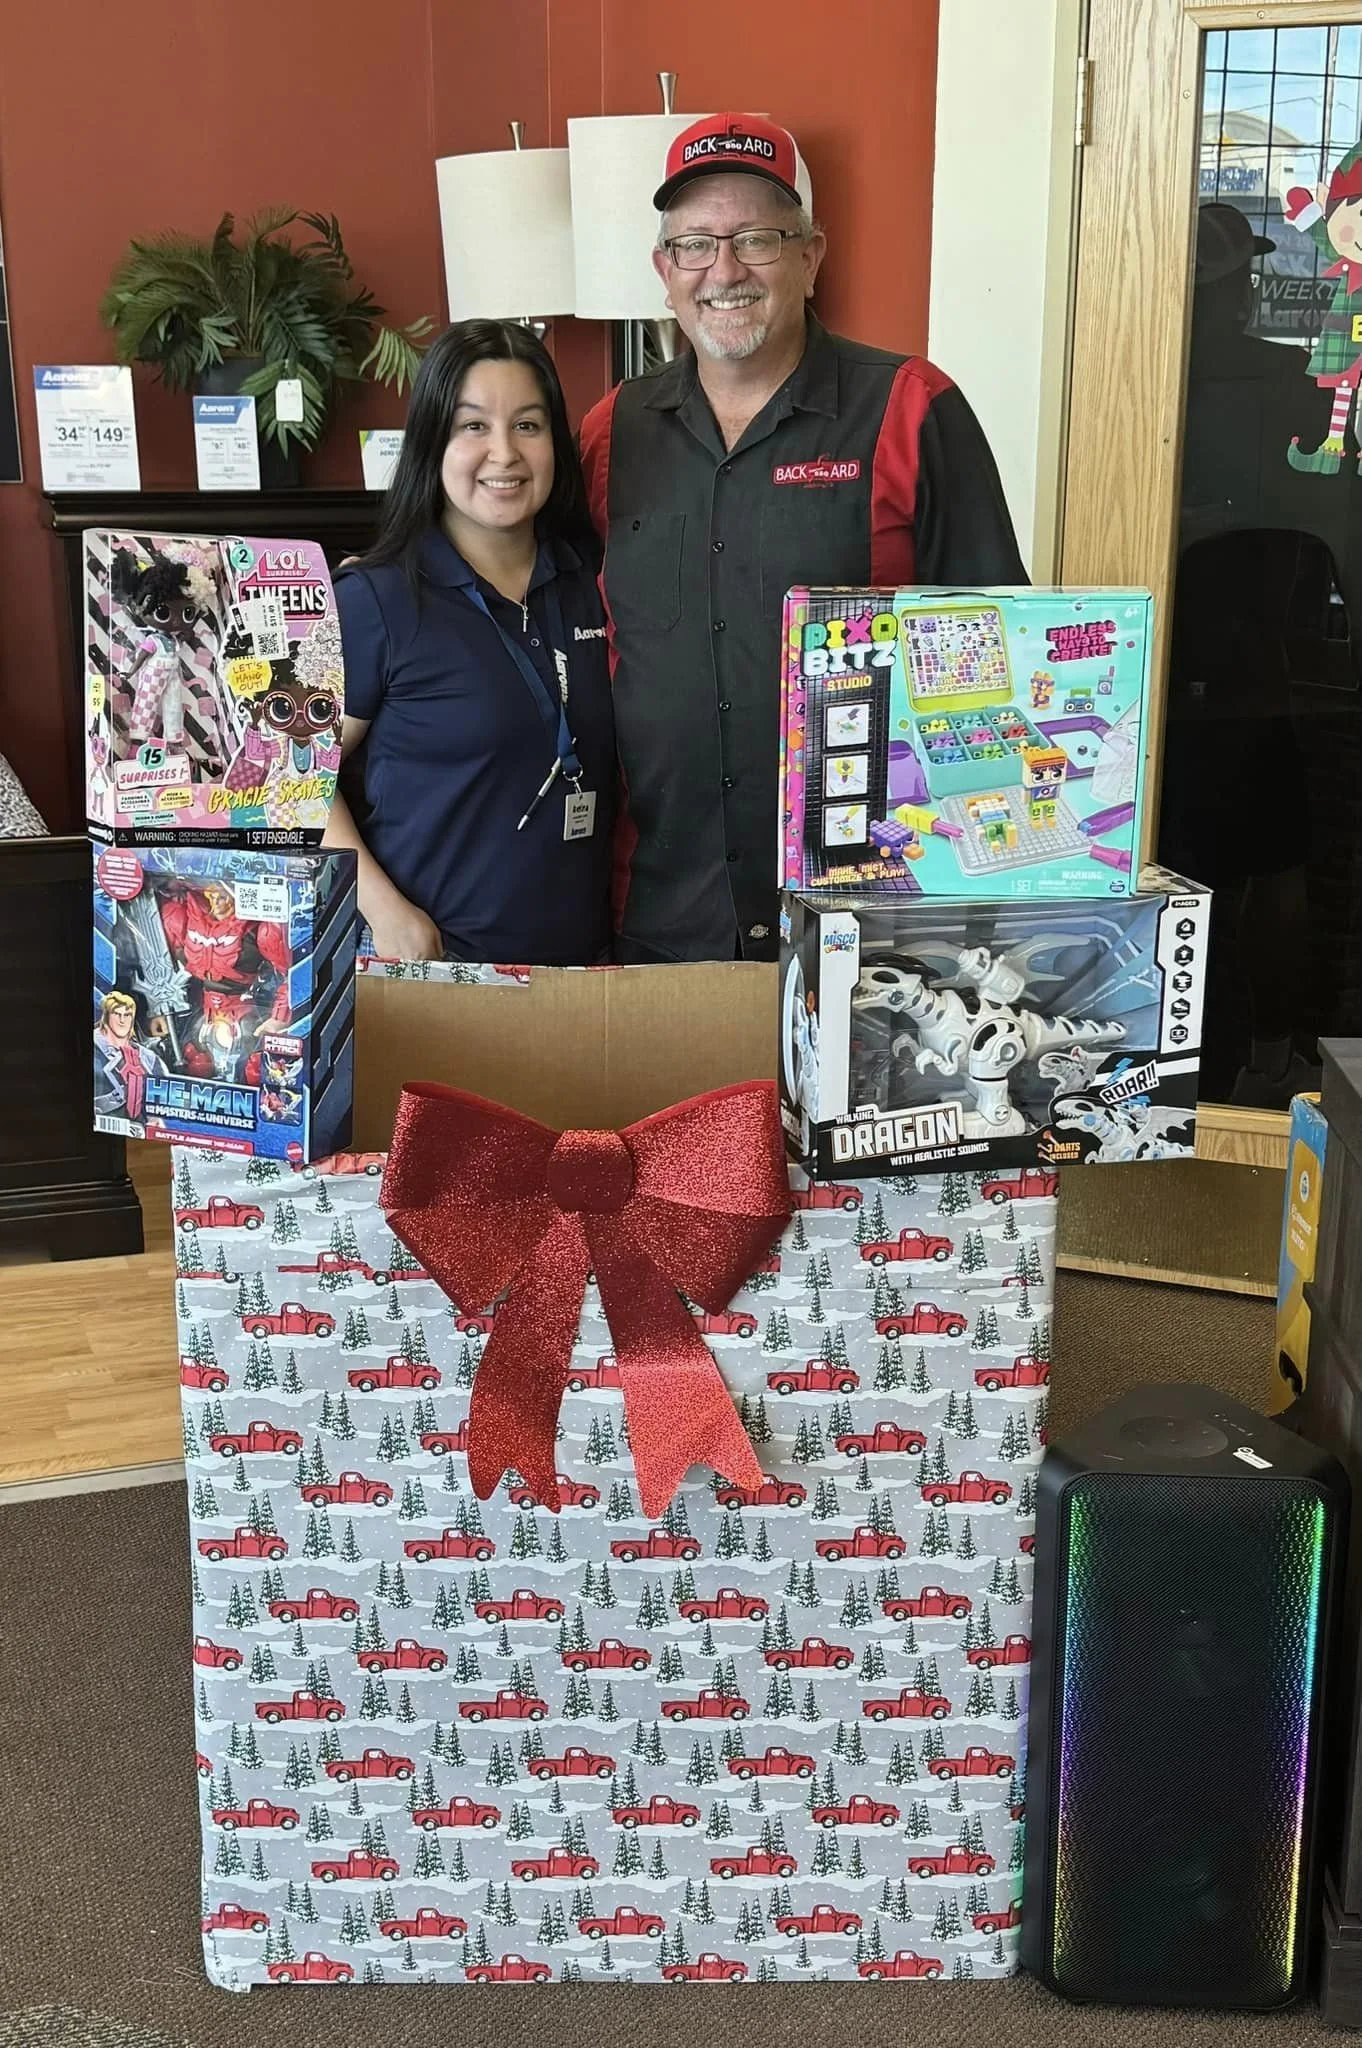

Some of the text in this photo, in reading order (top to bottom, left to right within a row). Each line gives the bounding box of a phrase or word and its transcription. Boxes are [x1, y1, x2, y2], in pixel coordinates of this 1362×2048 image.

[685, 137, 717, 161] BACK
[776, 465, 807, 481] BACK
[239, 549, 248, 563] 2
[803, 611, 898, 652] PIXO
[1047, 620, 1116, 641] ENDLESS
[1057, 634, 1105, 650] WAYS TO
[803, 640, 897, 676] BITZ
[232, 661, 263, 674] LET'S
[236, 673, 263, 684] HANG
[239, 681, 263, 691] OUT!
[826, 675, 872, 691] STUDIO
[144, 748, 162, 765] 15
[208, 776, 336, 814] GRACIE SKATES
[134, 831, 176, 841] WARNING:
[810, 873, 862, 887] CUSTOMIZE
[879, 868, 905, 879] PLAY!
[823, 931, 856, 946] MISCO
[1101, 1062, 1158, 1102] ROAR!!
[146, 1078, 254, 1118] HE-MAN
[155, 1105, 197, 1120] MASTERS
[205, 1113, 256, 1129] UNIVERSE
[835, 1110, 874, 1125] WALKING
[832, 1107, 959, 1163] DRAGON
[890, 1142, 989, 1167] WITH REALISTIC SOUNDS
[1054, 1142, 1080, 1152] DARTS
